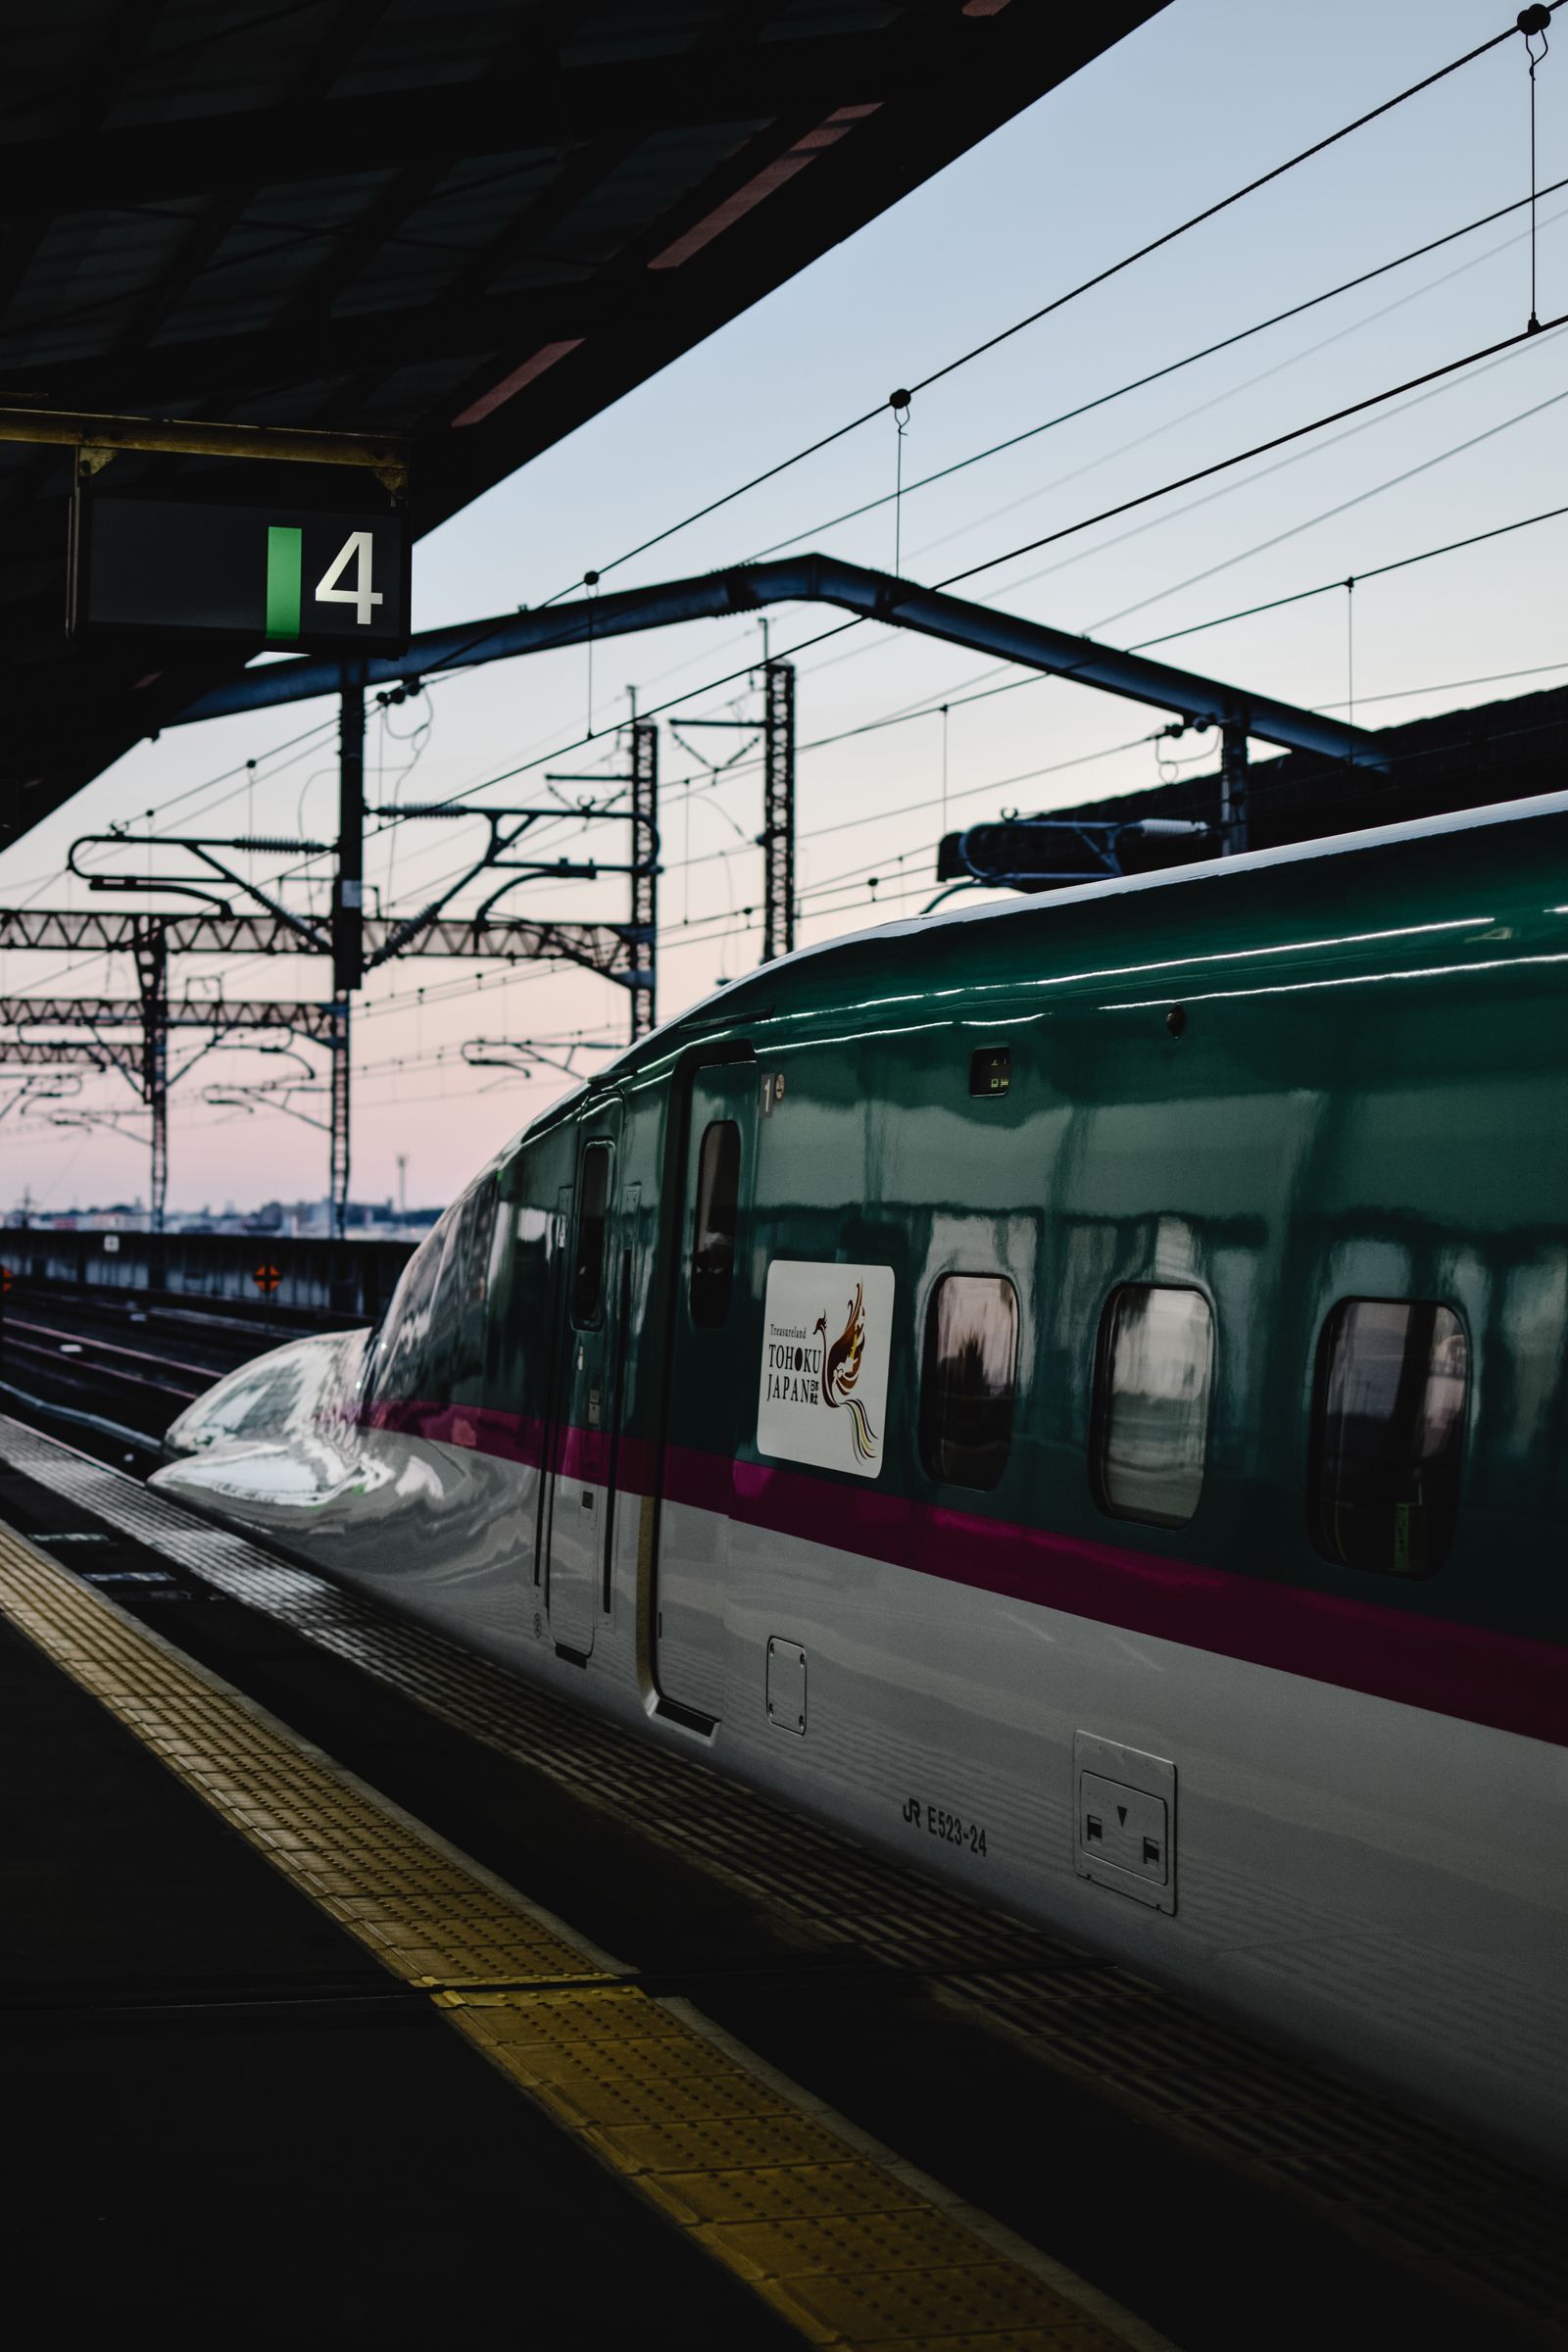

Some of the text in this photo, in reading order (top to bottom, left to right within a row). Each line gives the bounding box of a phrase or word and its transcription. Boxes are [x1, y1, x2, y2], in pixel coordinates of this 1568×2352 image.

[315, 531, 383, 624] 4
[764, 1079, 770, 1112] 1
[770, 1324, 807, 1340] Treasureland
[769, 1344, 822, 1374] TOHOKU
[766, 1374, 810, 1403] JAPAN
[904, 1797, 987, 1857] JR E523-24
